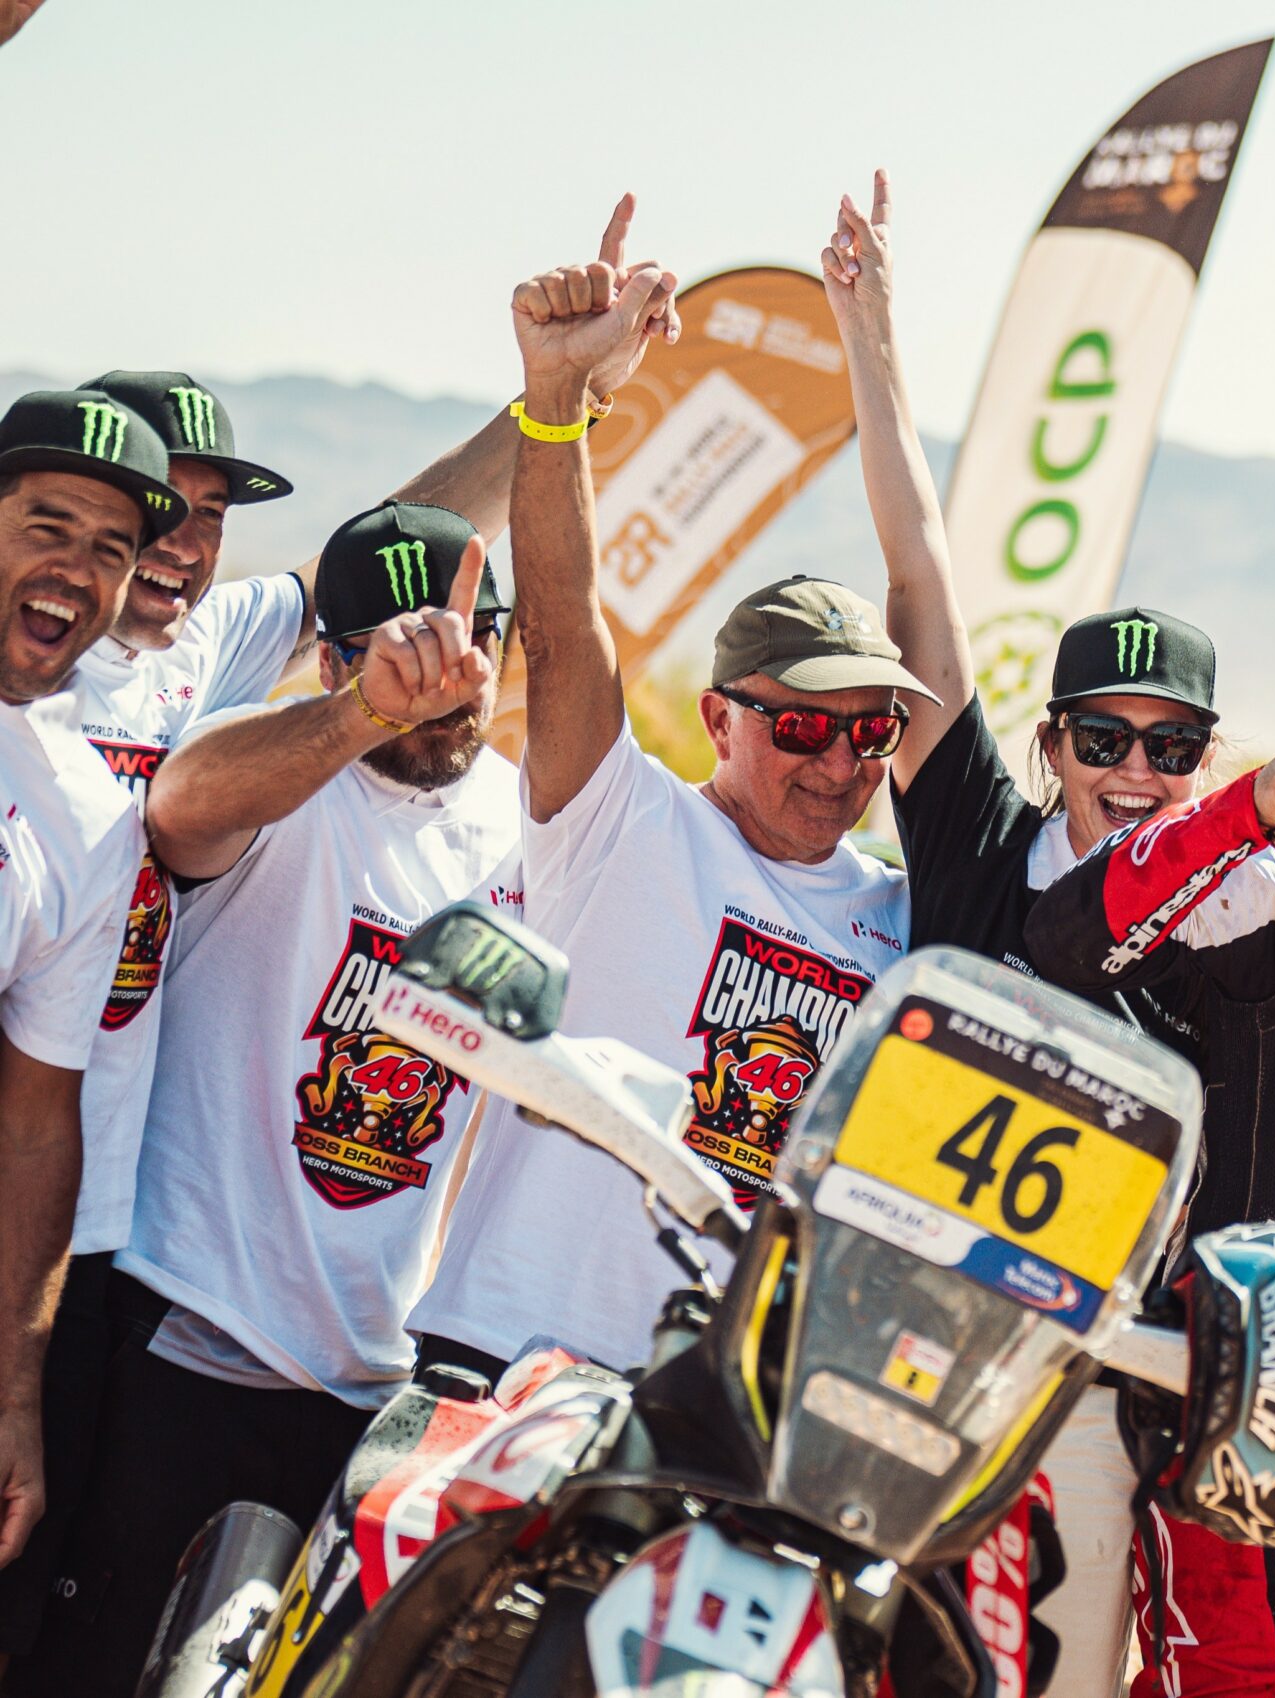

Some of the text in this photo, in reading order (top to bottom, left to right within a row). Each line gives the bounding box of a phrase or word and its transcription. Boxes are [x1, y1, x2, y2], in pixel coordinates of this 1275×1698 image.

[1004, 331, 1117, 585] OCP
[82, 722, 113, 738] WORLD
[353, 903, 387, 925] WORLD
[725, 905, 808, 946] WORLD RALLY-RAID
[114, 968, 159, 982] BRANC
[745, 933, 862, 1002] WORLD
[1003, 952, 1034, 977] WORLD
[409, 1002, 482, 1052] Hero
[702, 948, 857, 1063] CHAMPIO
[350, 1054, 430, 1099] 46
[735, 1053, 814, 1103] 46
[947, 1013, 1029, 1063] RALLYE
[1031, 1049, 1066, 1080] DU
[1065, 1066, 1147, 1121] MAROC
[302, 1155, 393, 1191] HERO MOTOSPORTS
[342, 1149, 423, 1181] BRANCH
[685, 1128, 774, 1174] OSS BRA
[936, 1094, 1082, 1234] 46
